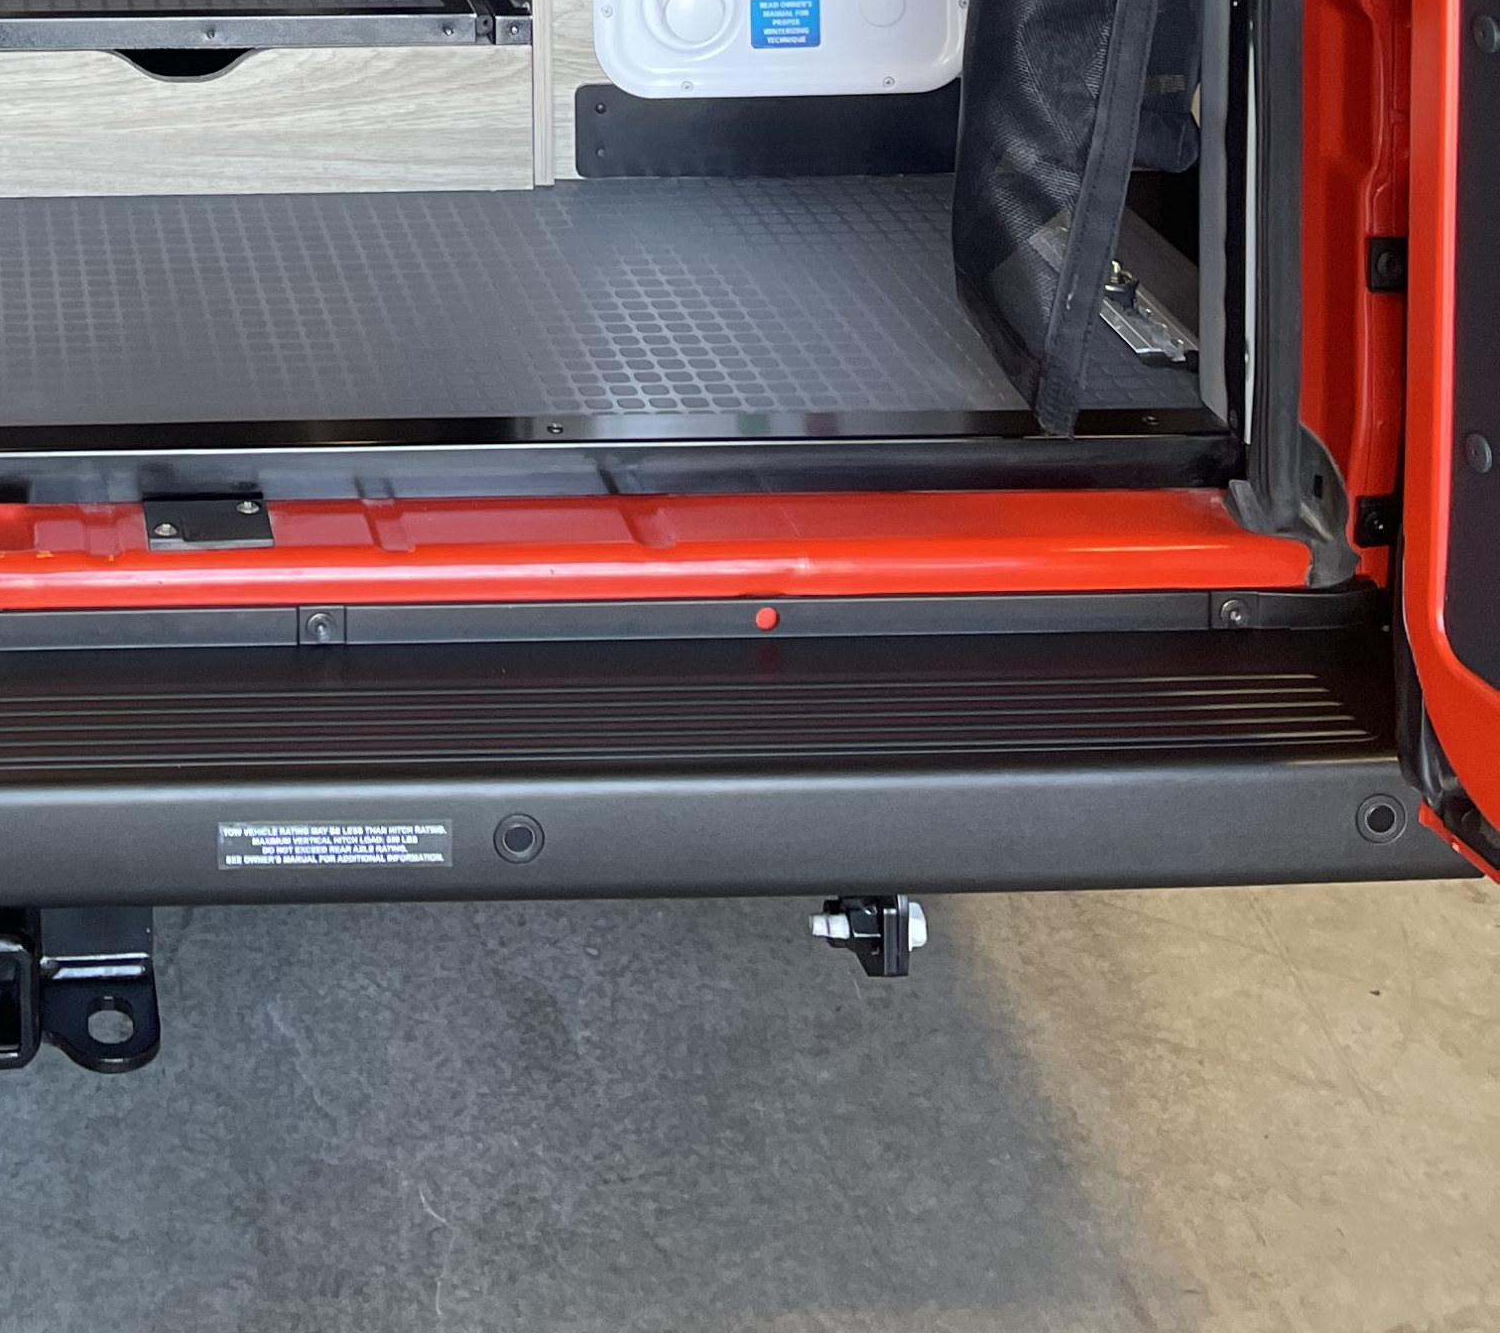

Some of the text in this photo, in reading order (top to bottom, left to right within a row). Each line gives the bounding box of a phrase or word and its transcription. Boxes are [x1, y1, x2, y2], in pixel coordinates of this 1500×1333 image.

[759, 0, 813, 9] READ OWNER'S
[762, 10, 793, 18] MANUAL
[771, 18, 800, 26] PROPER
[766, 35, 807, 44] TECHNIQUE
[223, 828, 242, 837] TOW
[243, 827, 278, 837] VEHICLE
[279, 826, 310, 836] RATING
[310, 826, 329, 835] MAY
[342, 826, 364, 835] LESS
[364, 826, 388, 834] THAN
[388, 825, 414, 834] HITCH
[251, 836, 292, 846] MAXIMUM
[292, 836, 333, 845] VERTICAL
[333, 835, 359, 844] HITCH
[261, 846, 275, 855] DO
[275, 846, 294, 854] NOT
[294, 846, 328, 854] EXCEED
[329, 845, 352, 853] REAR
[352, 844, 375, 853] AXLE
[225, 855, 243, 865] SEE
[243, 855, 282, 864] OWNER'S
[282, 854, 318, 864] MANUAL
[318, 854, 336, 863] FOR
[337, 853, 386, 863] ADDITIONAL
